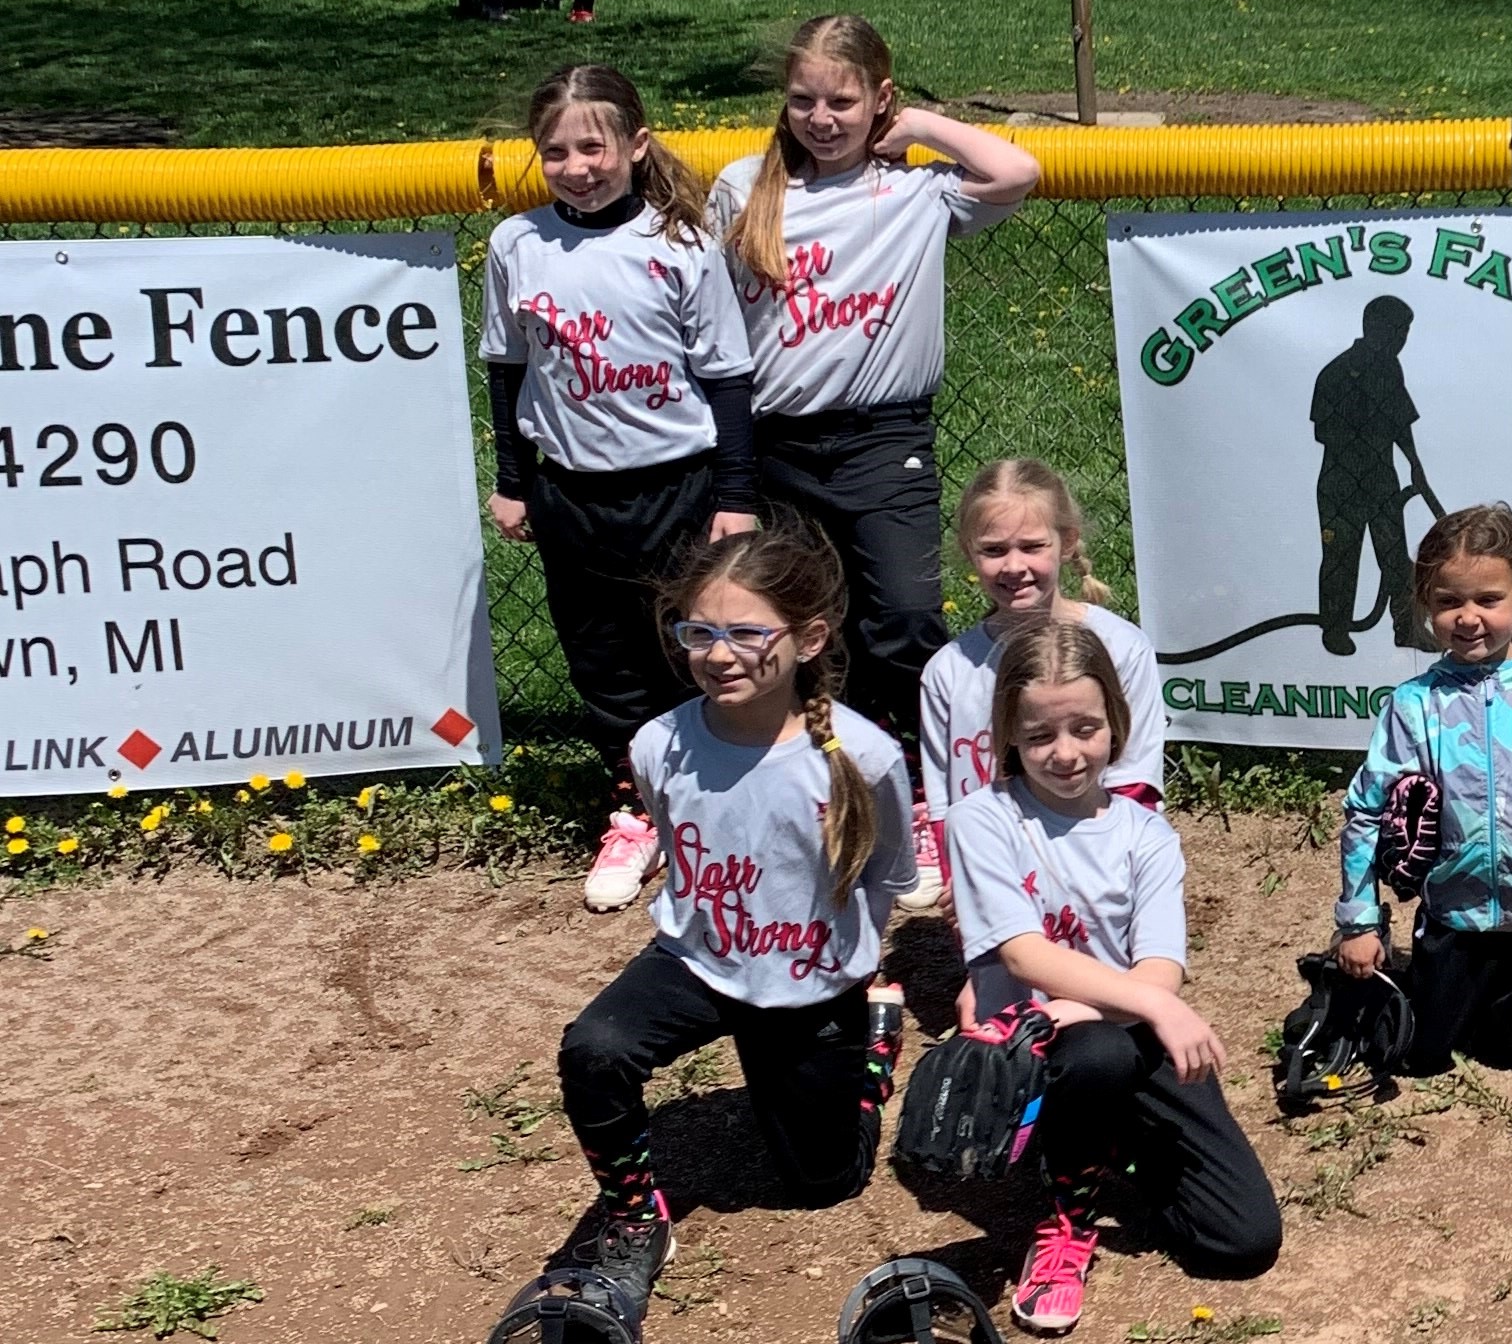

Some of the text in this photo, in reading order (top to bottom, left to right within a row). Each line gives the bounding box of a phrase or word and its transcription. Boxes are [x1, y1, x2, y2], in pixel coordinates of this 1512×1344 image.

[0, 286, 440, 371] ne Fence
[1140, 226, 1412, 386] GREEN'S
[559, 339, 682, 410] Strong
[118, 532, 299, 592] Road
[104, 618, 185, 674] MI
[4, 716, 414, 770] LINK ALUMINUM
[673, 821, 763, 899] Starr
[695, 887, 841, 981] Strong
